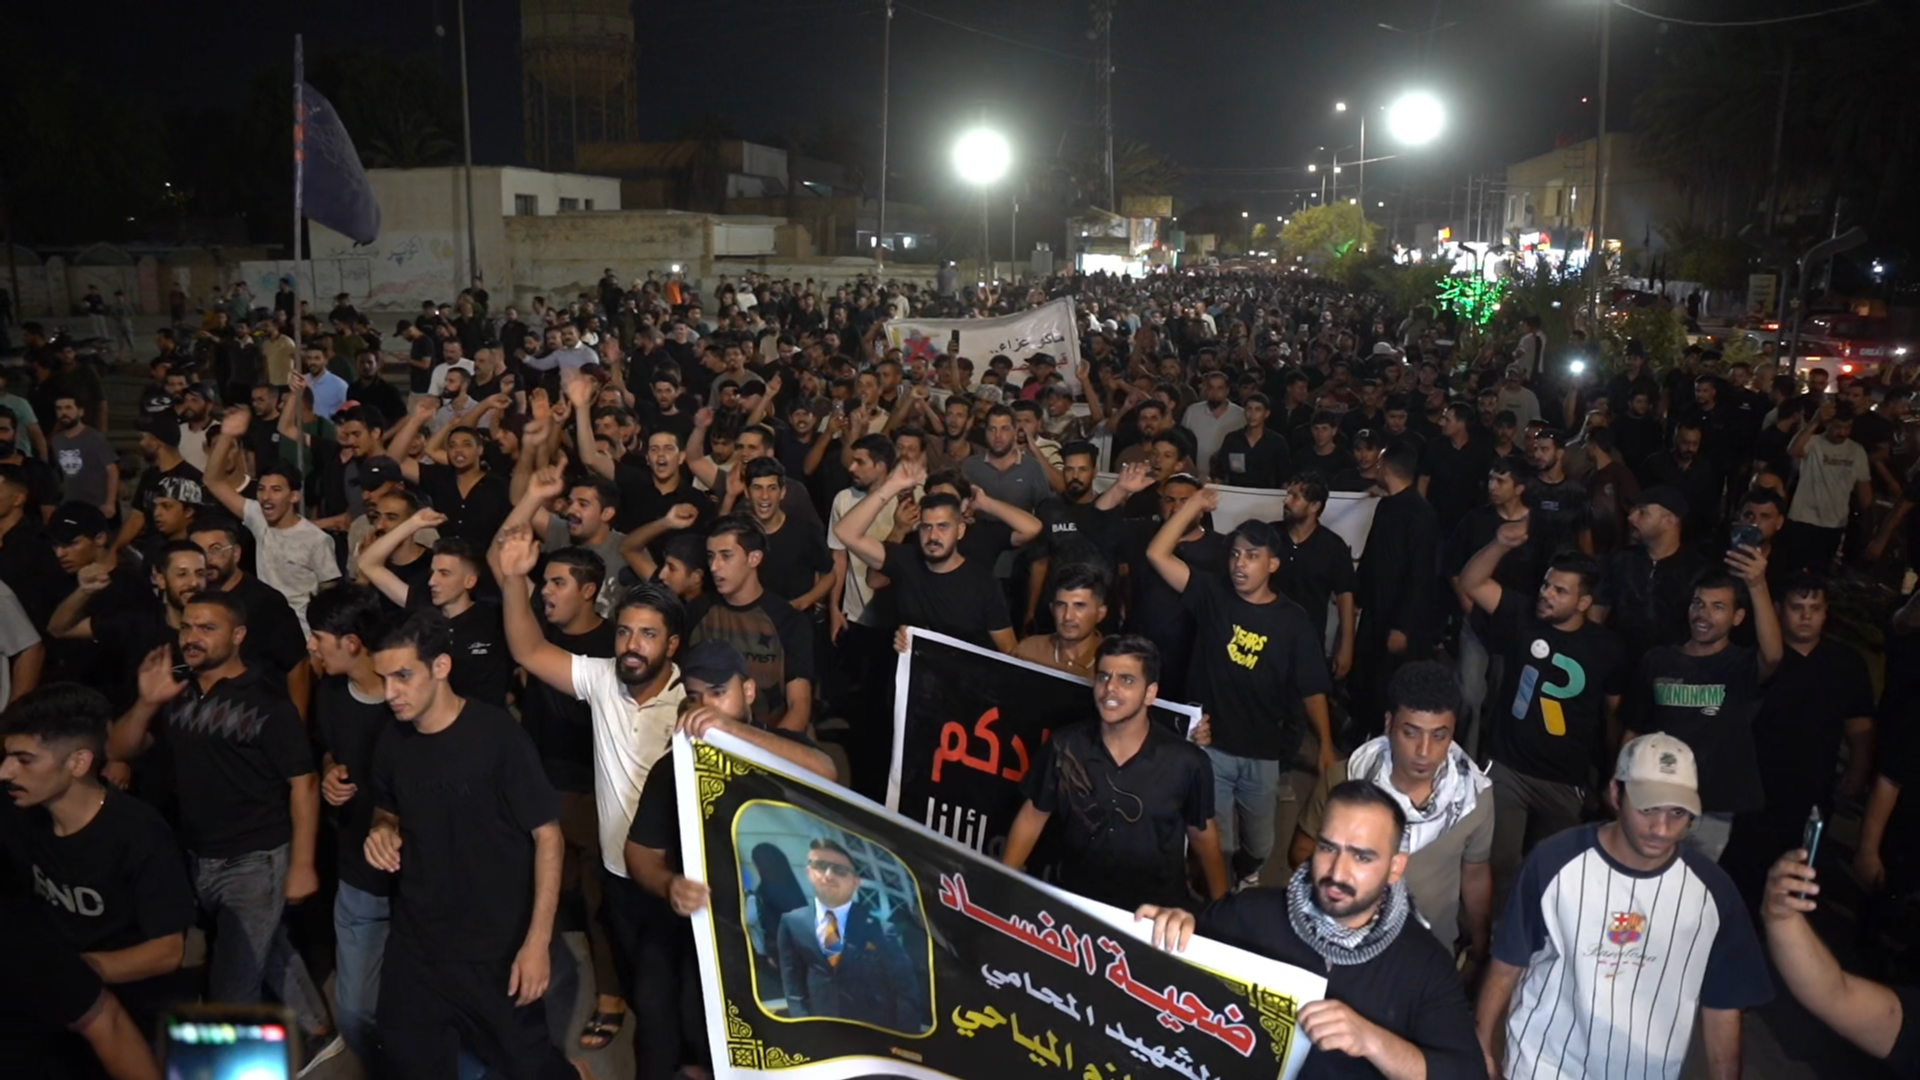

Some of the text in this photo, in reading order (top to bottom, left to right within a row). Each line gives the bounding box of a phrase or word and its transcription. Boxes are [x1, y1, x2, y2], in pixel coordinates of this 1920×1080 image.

[1038, 333, 1065, 349] ماكو
[1230, 624, 1268, 653] YEARS
[938, 872, 1257, 1058] ضحية الفساد
[982, 964, 1095, 1026] المحامي
[952, 1005, 1073, 1071] المياحي
